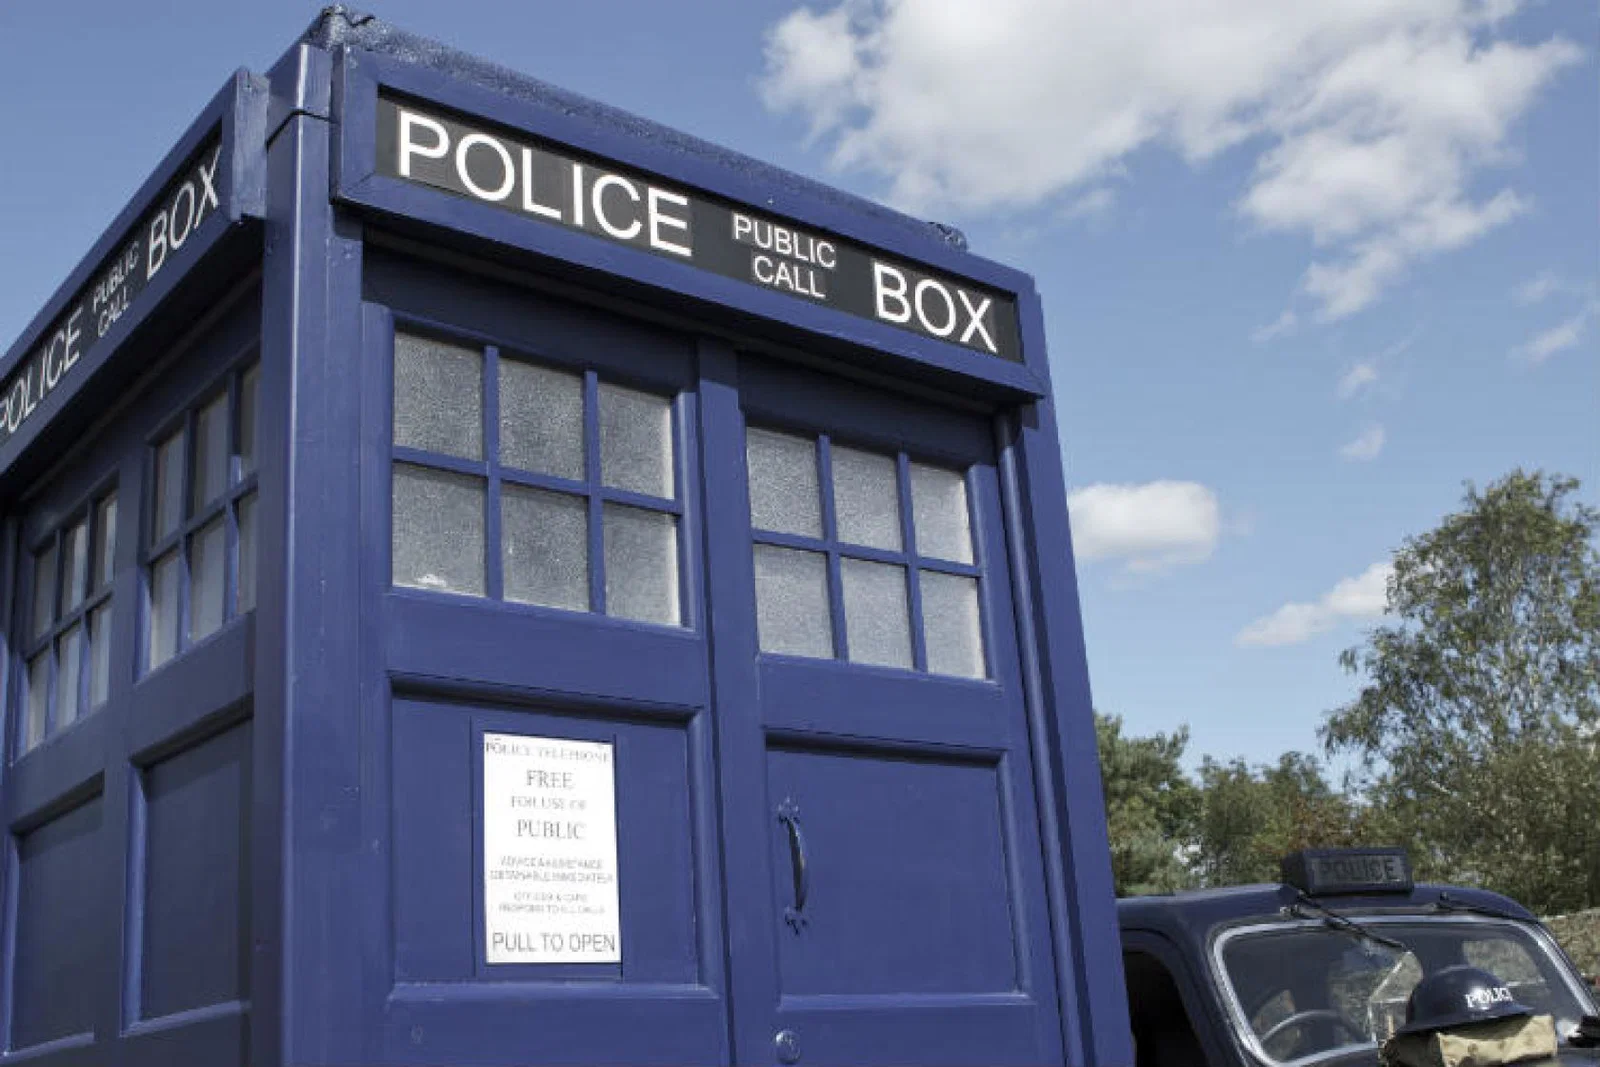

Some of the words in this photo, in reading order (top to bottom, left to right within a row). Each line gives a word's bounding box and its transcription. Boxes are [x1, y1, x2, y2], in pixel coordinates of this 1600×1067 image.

[398, 109, 693, 257] POLICE
[147, 144, 222, 281] BOX
[731, 212, 837, 268] PUBLIC
[754, 255, 826, 298] CALL
[97, 285, 130, 338] CALL
[872, 260, 998, 354] BOX
[526, 769, 574, 789] FREE
[517, 818, 587, 840] PUBLIC
[492, 931, 537, 953] PULL
[541, 931, 564, 953] TO
[569, 933, 615, 953] OPEN
